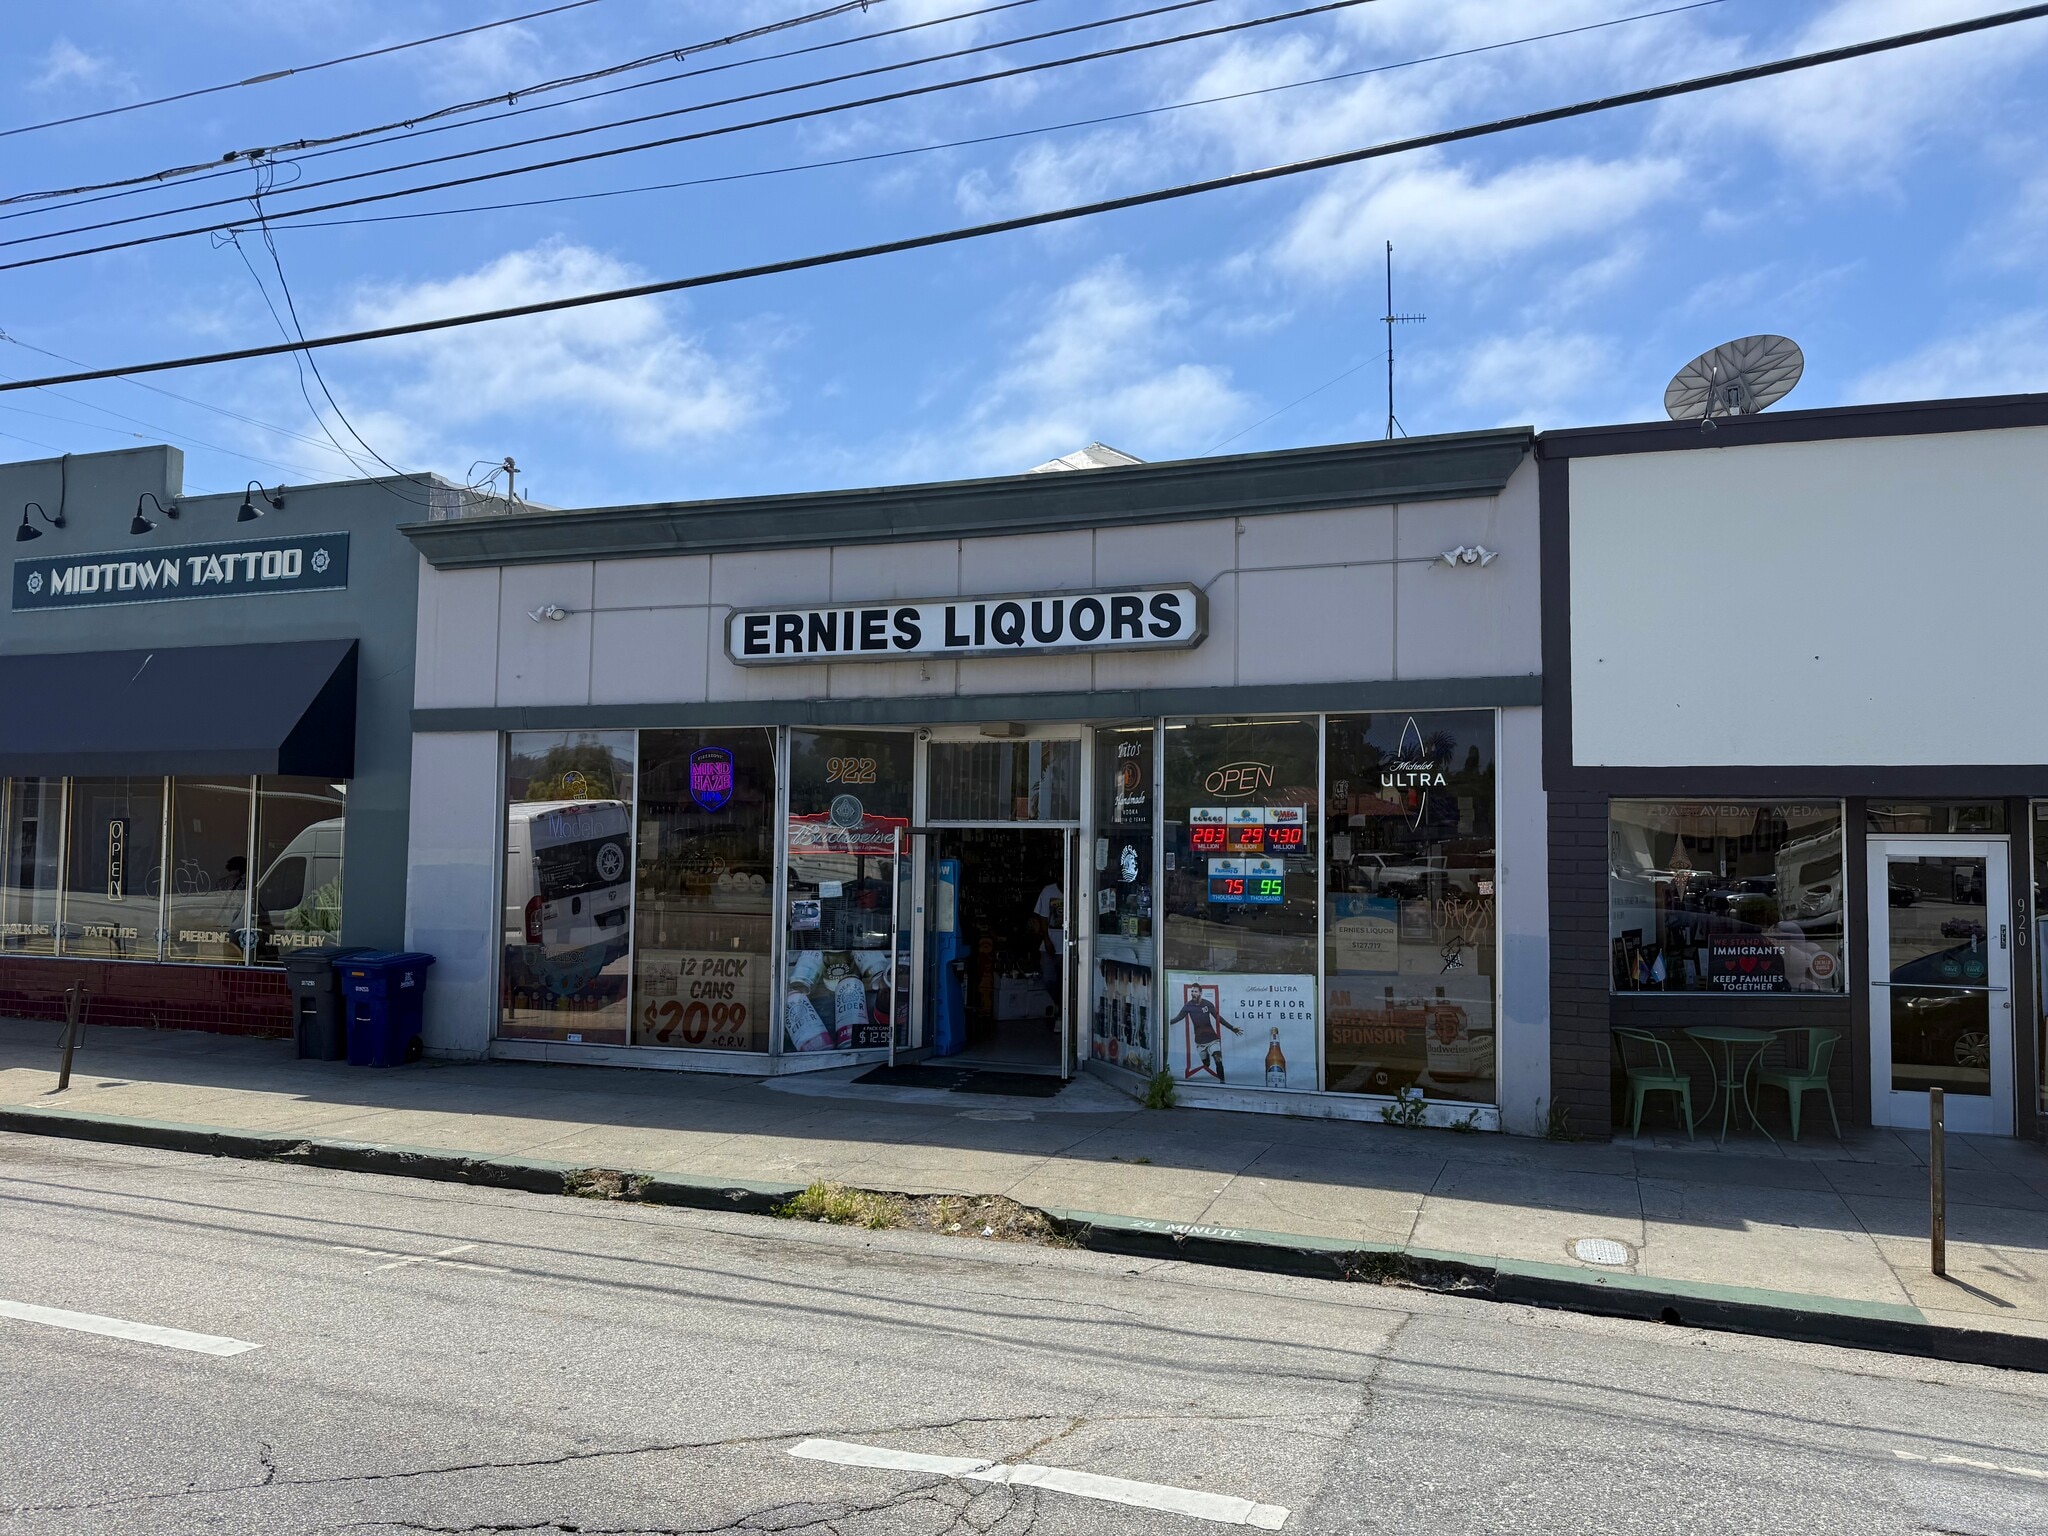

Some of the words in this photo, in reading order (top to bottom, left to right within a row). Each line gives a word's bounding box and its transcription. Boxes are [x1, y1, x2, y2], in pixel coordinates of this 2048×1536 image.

[50, 558, 180, 596] MIDTOWN
[186, 548, 304, 586] TATTOO
[744, 606, 922, 656] ERNIES
[944, 592, 1182, 648] LIQUORS
[1117, 741, 1141, 759] Tito's
[692, 762, 731, 776] MIND
[826, 757, 877, 784] 922
[1389, 761, 1435, 772] Michelob
[692, 776, 731, 791] HAZE
[1205, 765, 1275, 793] OPEN
[1380, 772, 1447, 787] ULTRA
[701, 791, 723, 802] IPA
[1700, 805, 1749, 817] AVEDA
[1772, 805, 1823, 817] AVEDA
[549, 815, 605, 839] Modelo
[788, 824, 896, 845] Budweise
[1240, 828, 1265, 844] 29
[1268, 828, 1303, 844] 430
[111, 822, 122, 898] OPEN
[1225, 879, 1244, 895] 75
[1260, 879, 1282, 895] 95
[2017, 898, 2027, 947] 920
[179, 930, 231, 944] PIERCING
[1339, 926, 1366, 934] ERNIES
[1367, 927, 1395, 935] LIQUOR
[265, 934, 327, 948] JEWELRY
[1714, 938, 1728, 946] WE
[1729, 938, 1761, 947] STAND
[1713, 946, 1786, 956] IMMIGRANTS
[679, 957, 698, 976] 12
[701, 958, 748, 978] PACK
[1713, 975, 1737, 983] KEEP
[1739, 975, 1784, 983] FAMILIES
[690, 979, 735, 1000] CANS
[1273, 985, 1298, 993] ULTRA
[1722, 983, 1774, 991] TOGETHER
[1240, 999, 1306, 1009] SUPERIOR
[1330, 990, 1352, 1006] AN
[838, 1003, 865, 1014] CIDER
[1234, 1012, 1272, 1020] LIGHT
[1281, 1012, 1313, 1021] BEER
[1333, 1028, 1407, 1045] SPONSOR
[1427, 1043, 1469, 1054] Budweise
[1129, 1220, 1156, 1229] 24
[1165, 1223, 1246, 1239] MINUTE
